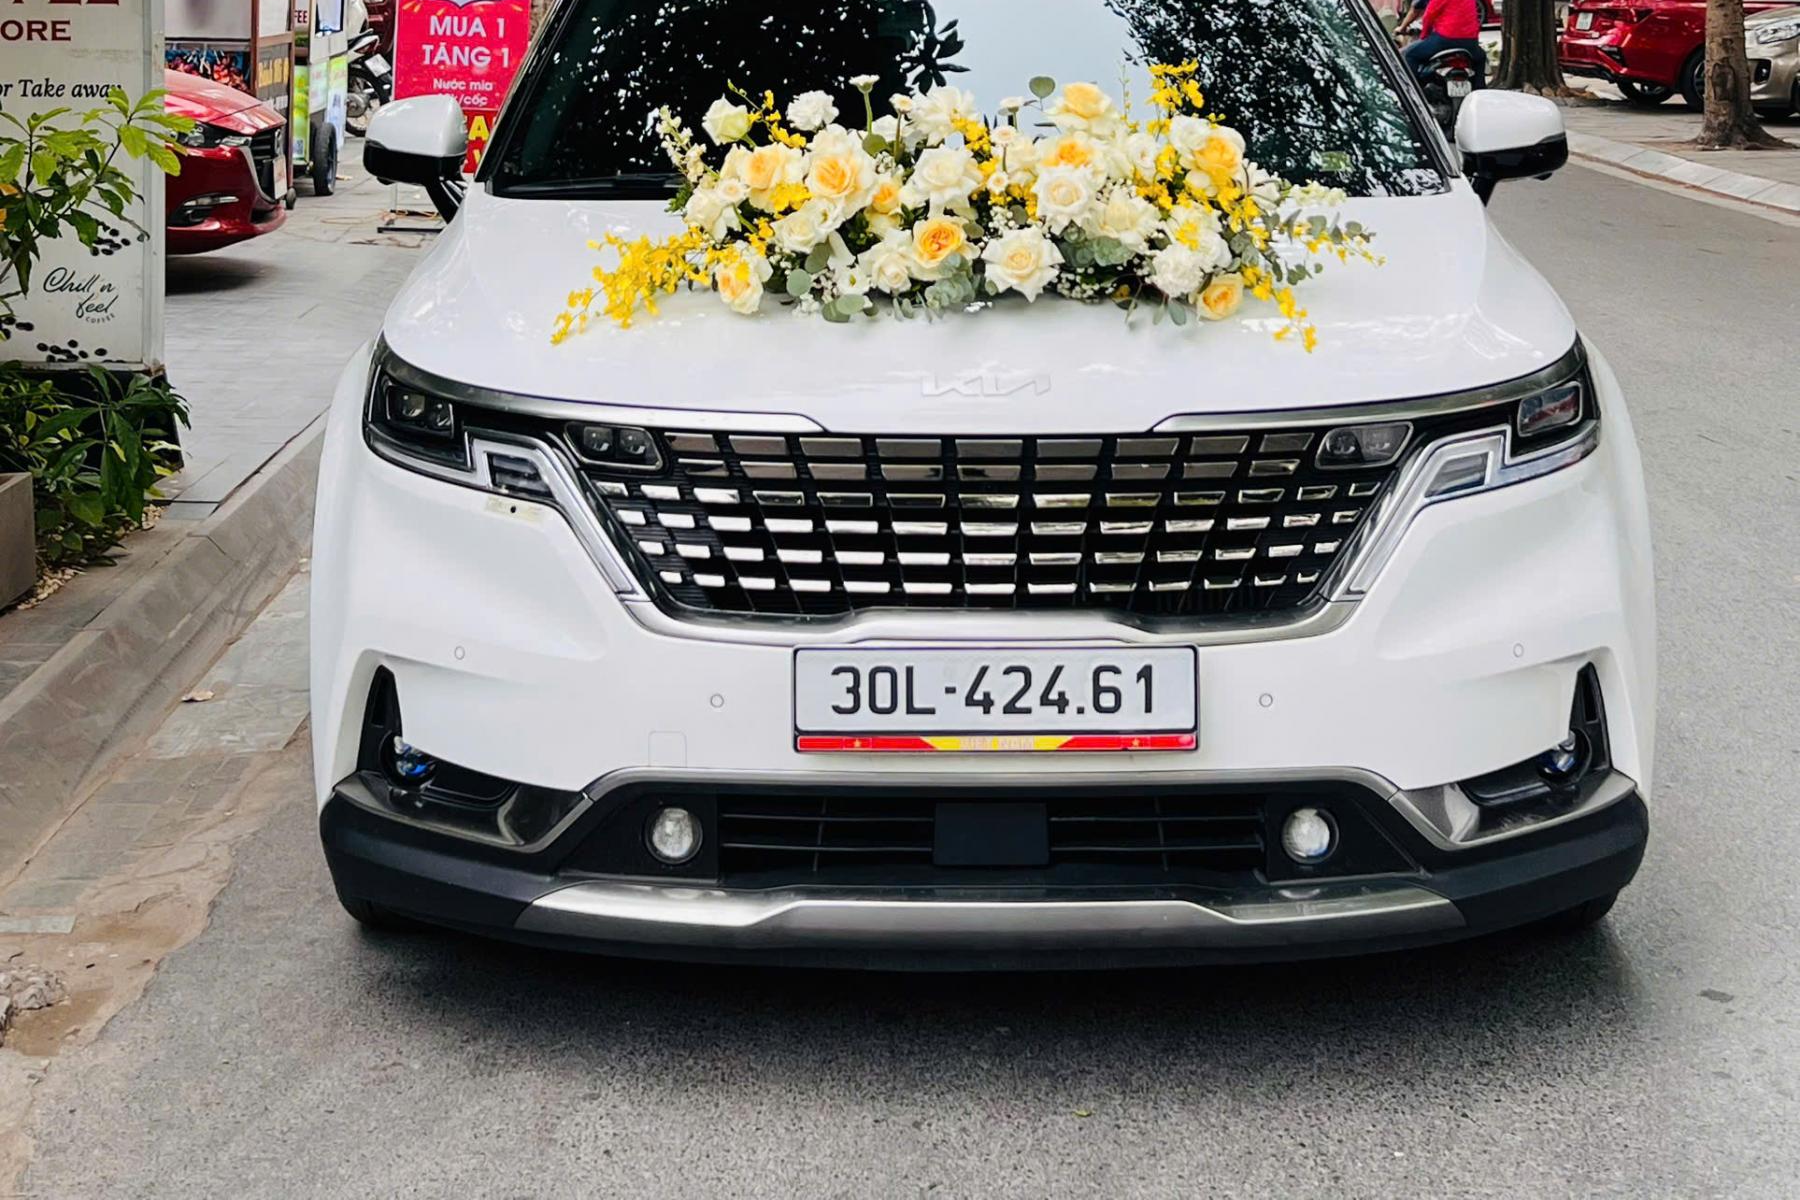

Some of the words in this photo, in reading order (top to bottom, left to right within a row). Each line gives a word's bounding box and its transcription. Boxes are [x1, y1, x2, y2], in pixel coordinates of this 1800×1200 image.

[0, 20, 71, 41] ORE
[429, 15, 487, 38] MUA
[496, 18, 505, 39] 1
[501, 47, 510, 68] 1
[18, 77, 65, 98] Take
[72, 82, 121, 104] awa
[43, 266, 100, 293] Chill
[76, 292, 119, 319] feel
[831, 664, 1154, 715] 30L-424.61
